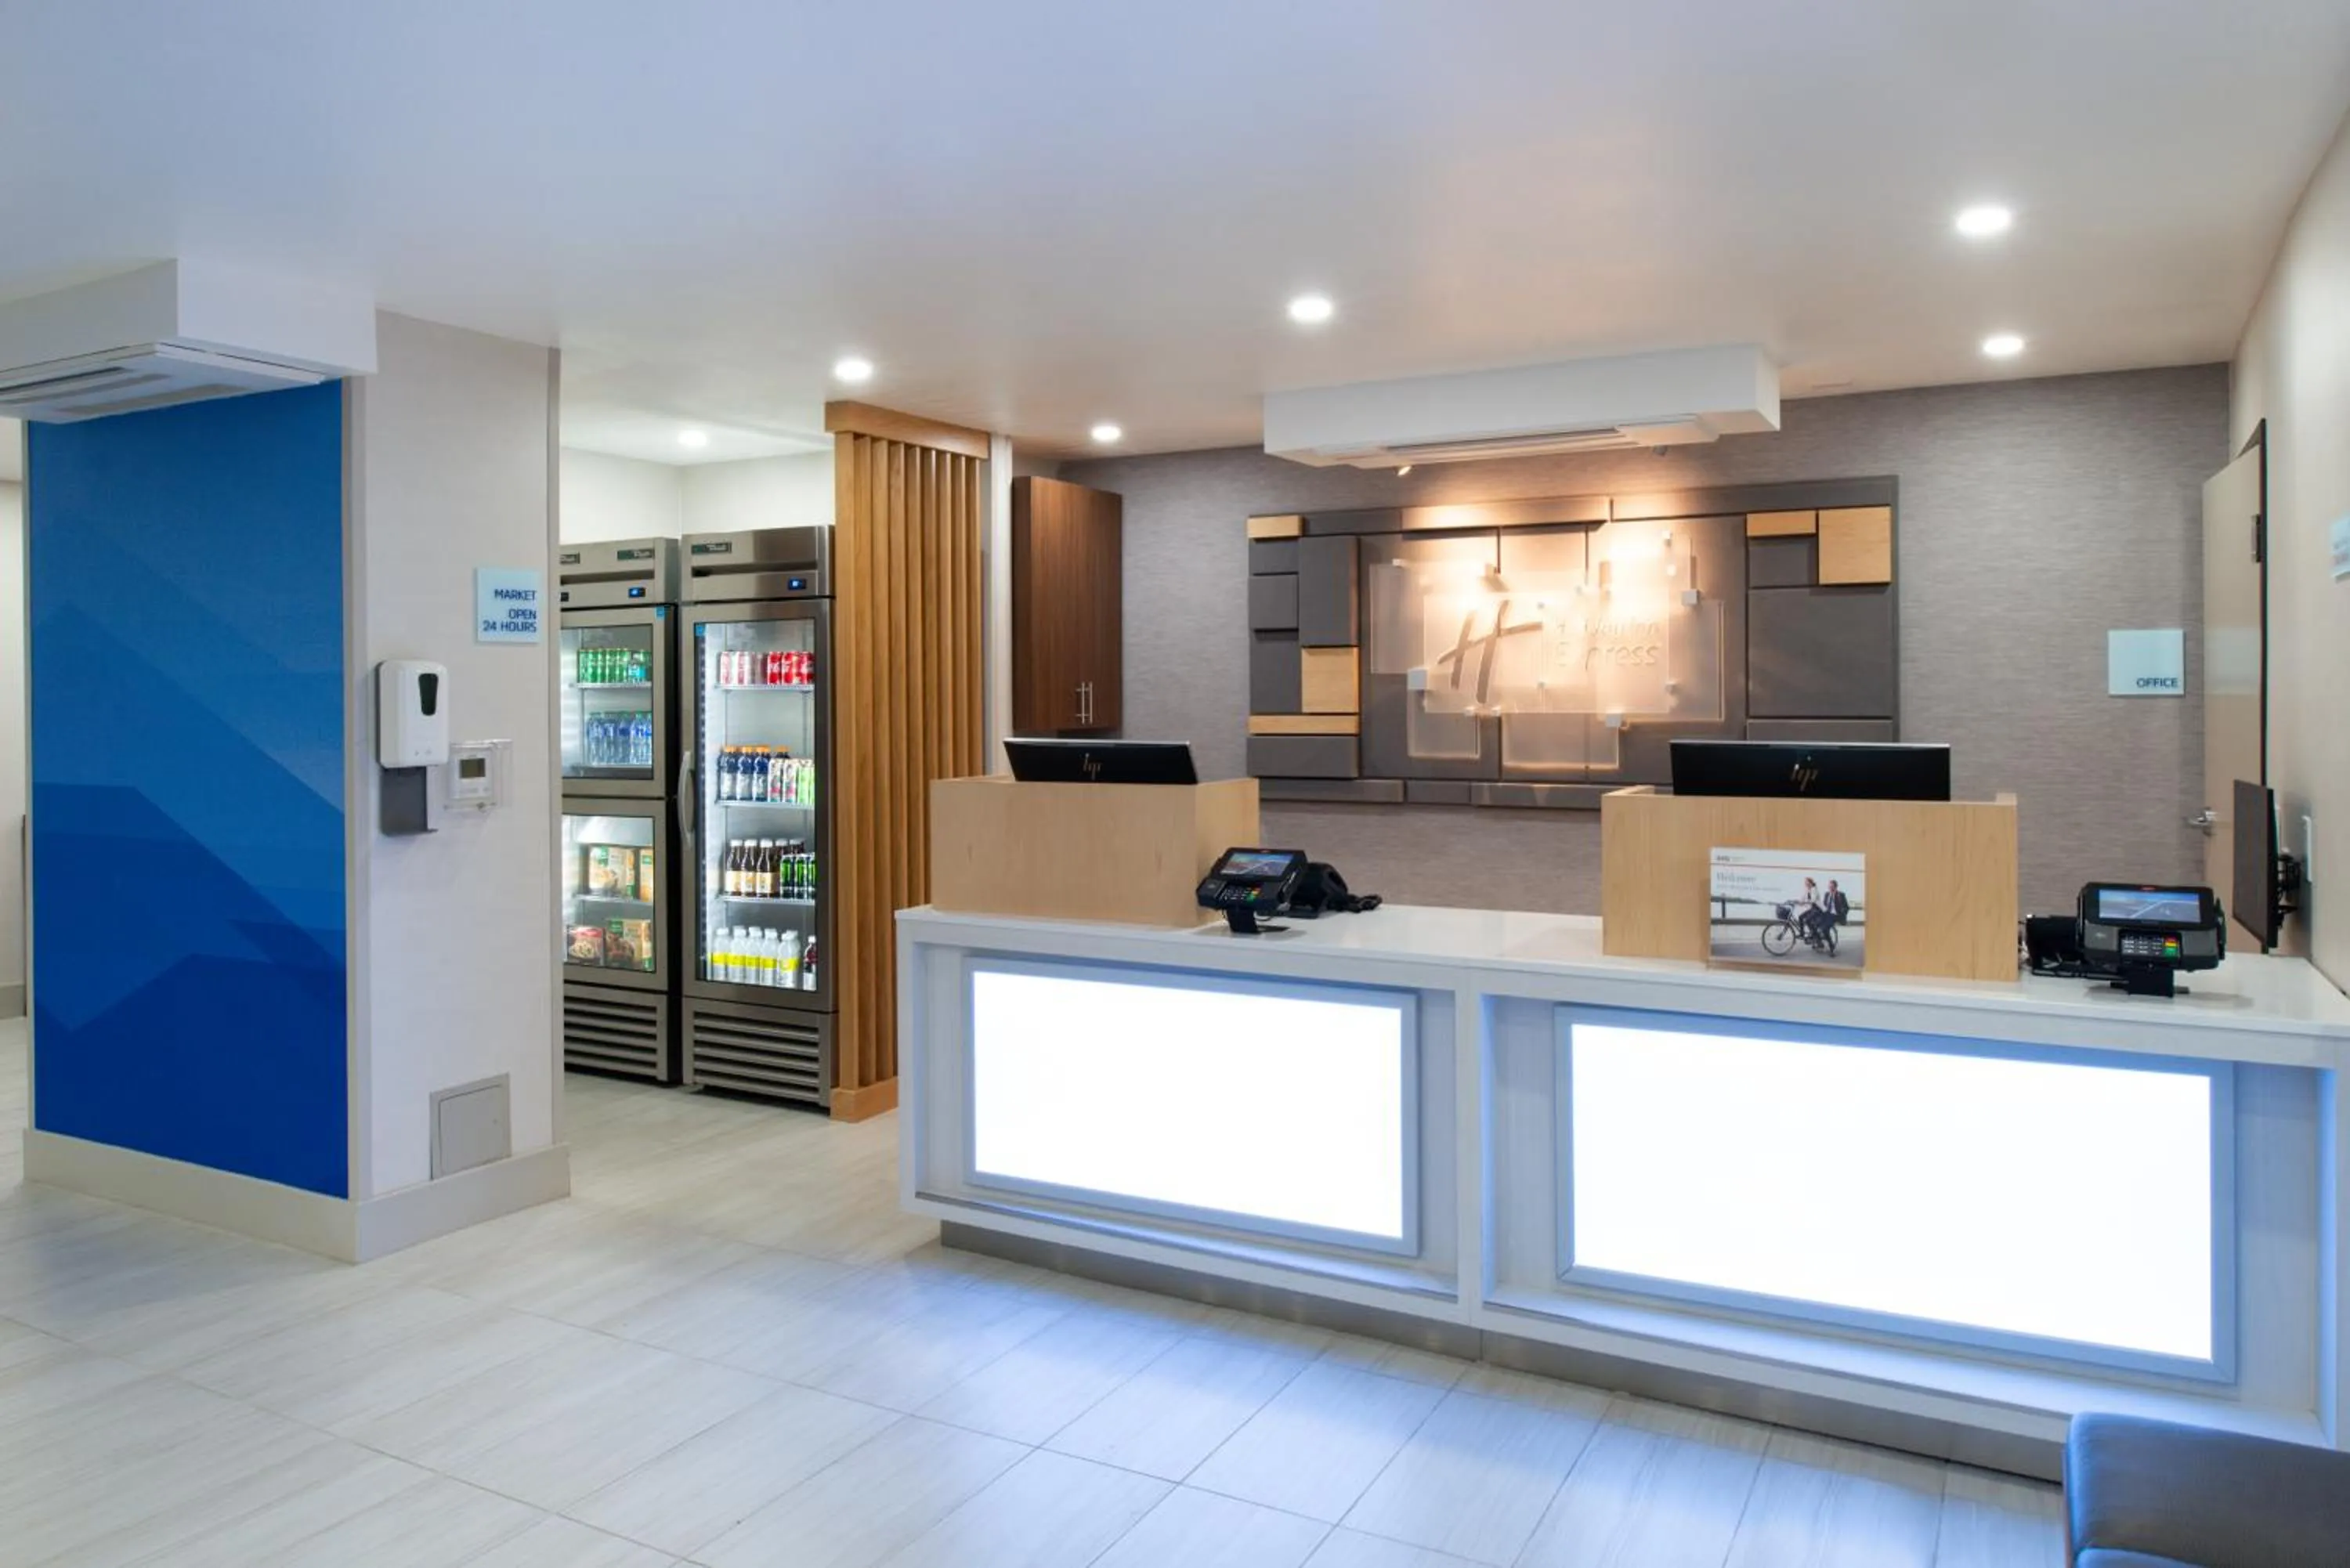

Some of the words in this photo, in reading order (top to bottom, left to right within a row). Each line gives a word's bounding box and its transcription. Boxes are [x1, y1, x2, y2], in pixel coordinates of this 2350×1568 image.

[494, 588, 537, 601] MARKET
[508, 608, 537, 620] OPEN
[483, 620, 497, 632] 24
[501, 621, 537, 633] HOURS
[2136, 677, 2179, 688] OFFICE
